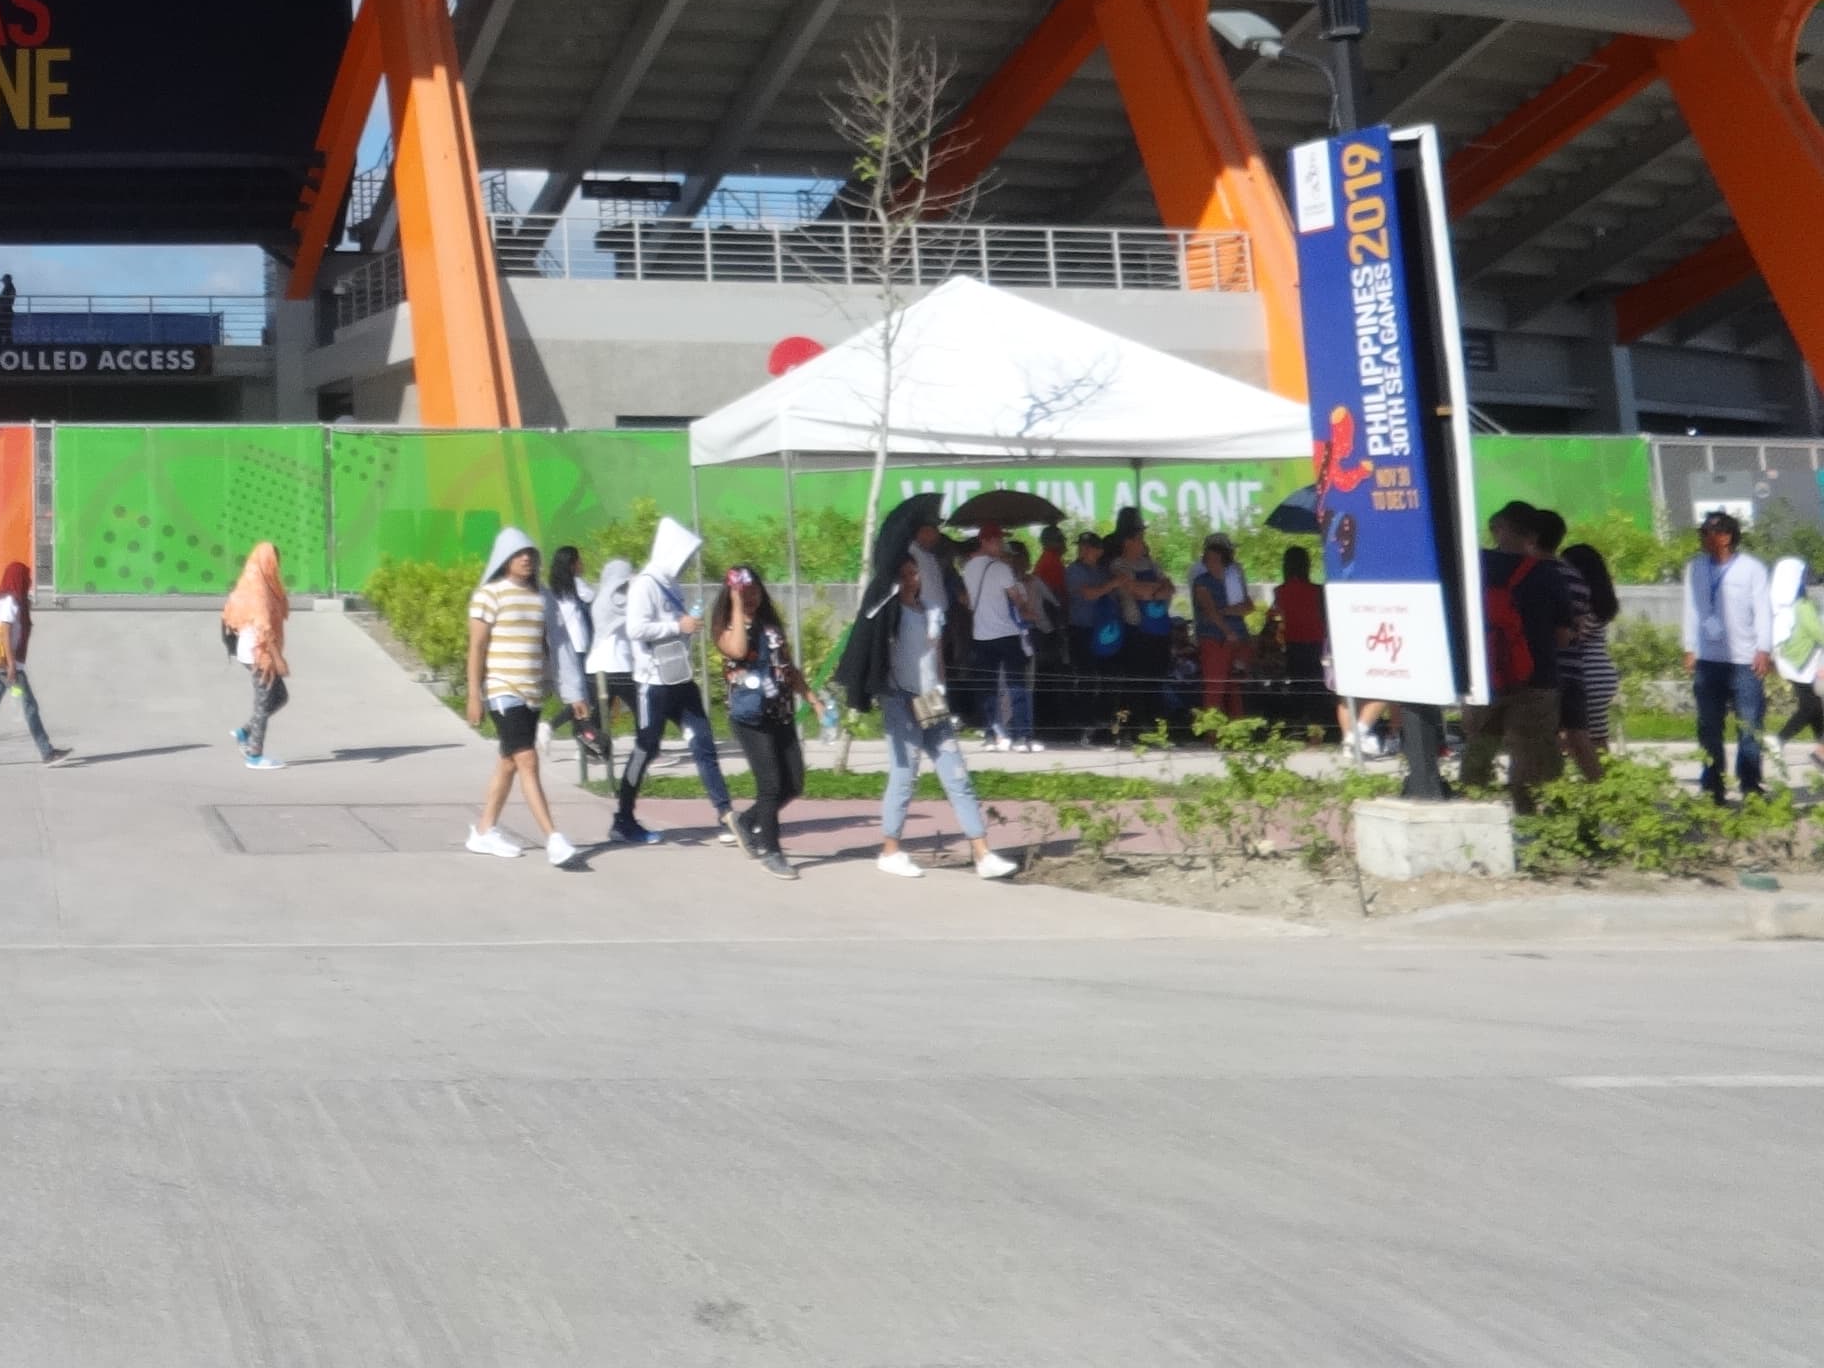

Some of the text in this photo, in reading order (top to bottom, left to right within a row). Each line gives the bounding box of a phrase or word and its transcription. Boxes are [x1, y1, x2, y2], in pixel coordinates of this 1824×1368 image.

[96, 349, 196, 371] ACCESS
[1341, 142, 1392, 457] PHILIPPINES 2019
[1374, 261, 1411, 457] 30TH SEA GAMES
[1177, 480, 1263, 535] ONE
